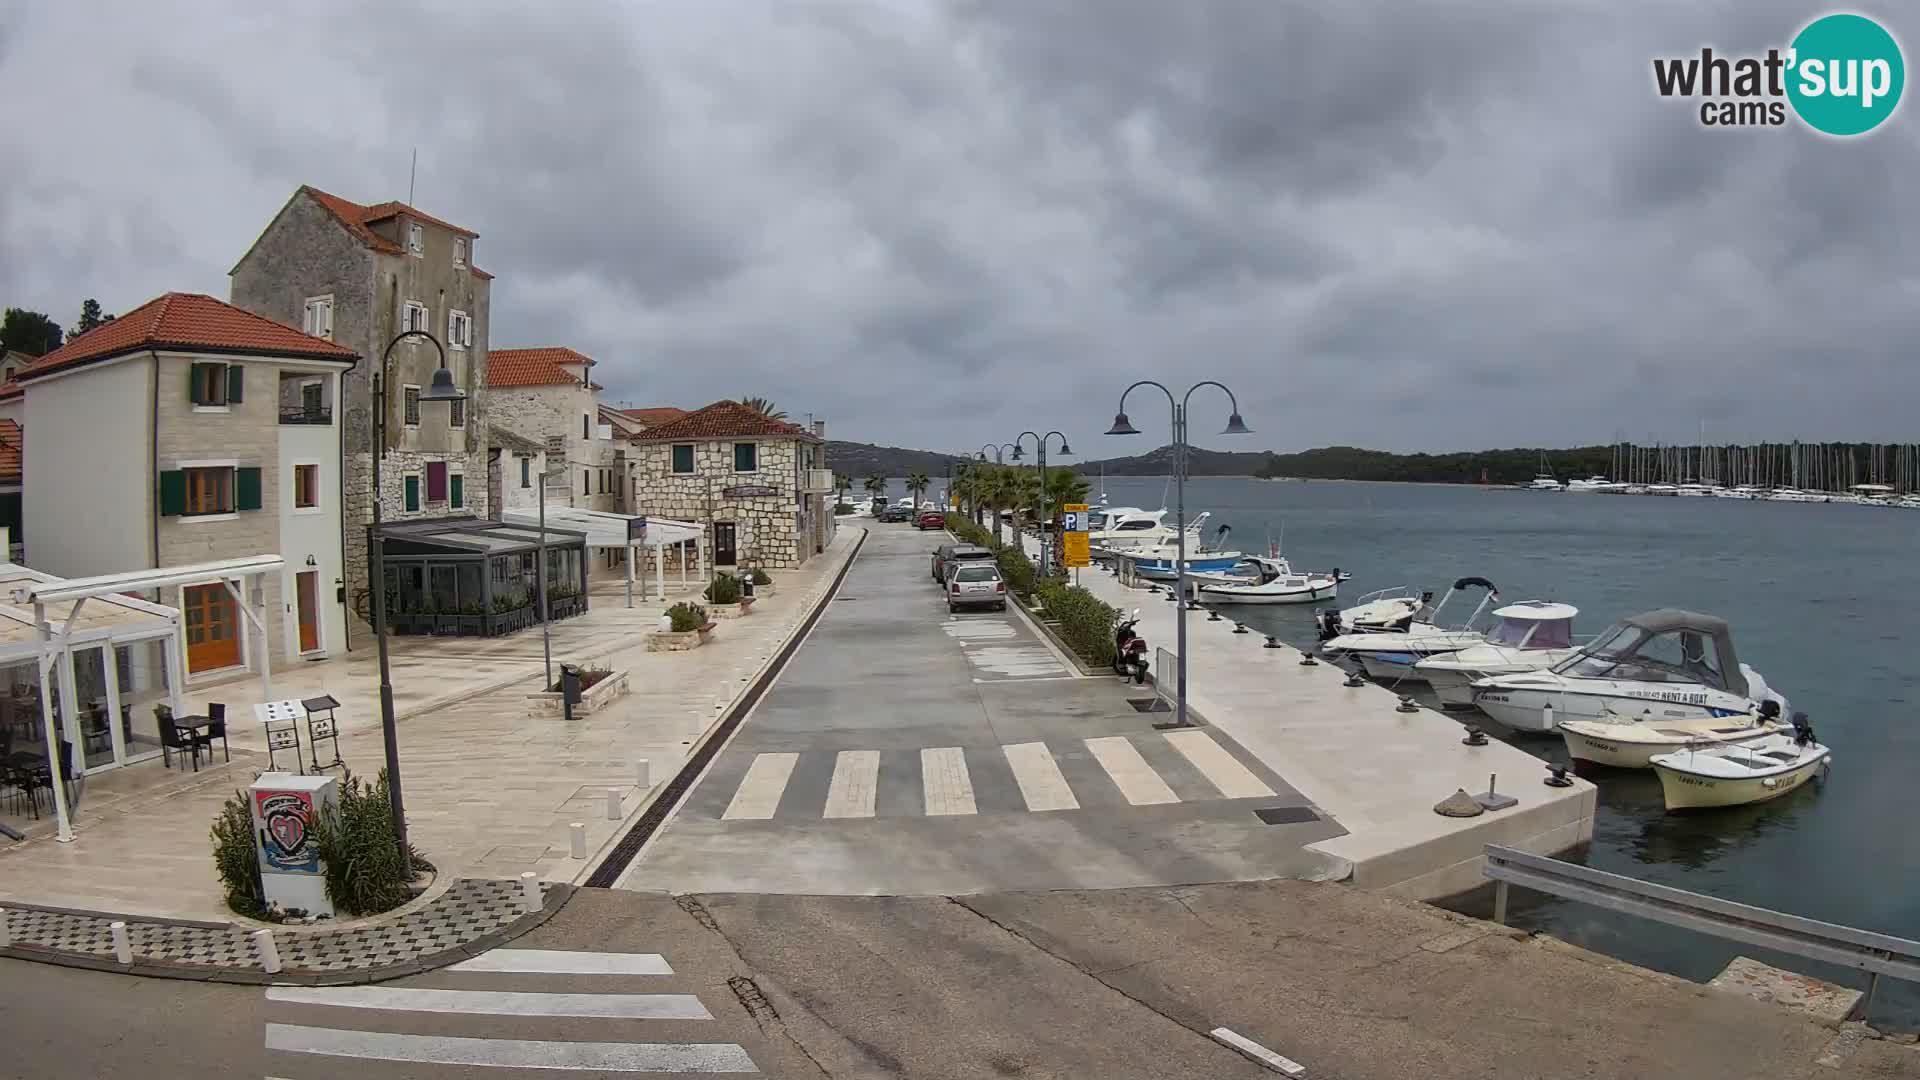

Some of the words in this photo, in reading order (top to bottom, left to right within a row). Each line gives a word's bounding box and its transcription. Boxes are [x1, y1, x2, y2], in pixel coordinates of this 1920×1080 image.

[1065, 514, 1076, 530] P
[1661, 691, 1681, 702] RENT
[1689, 693, 1709, 705] BOAT
